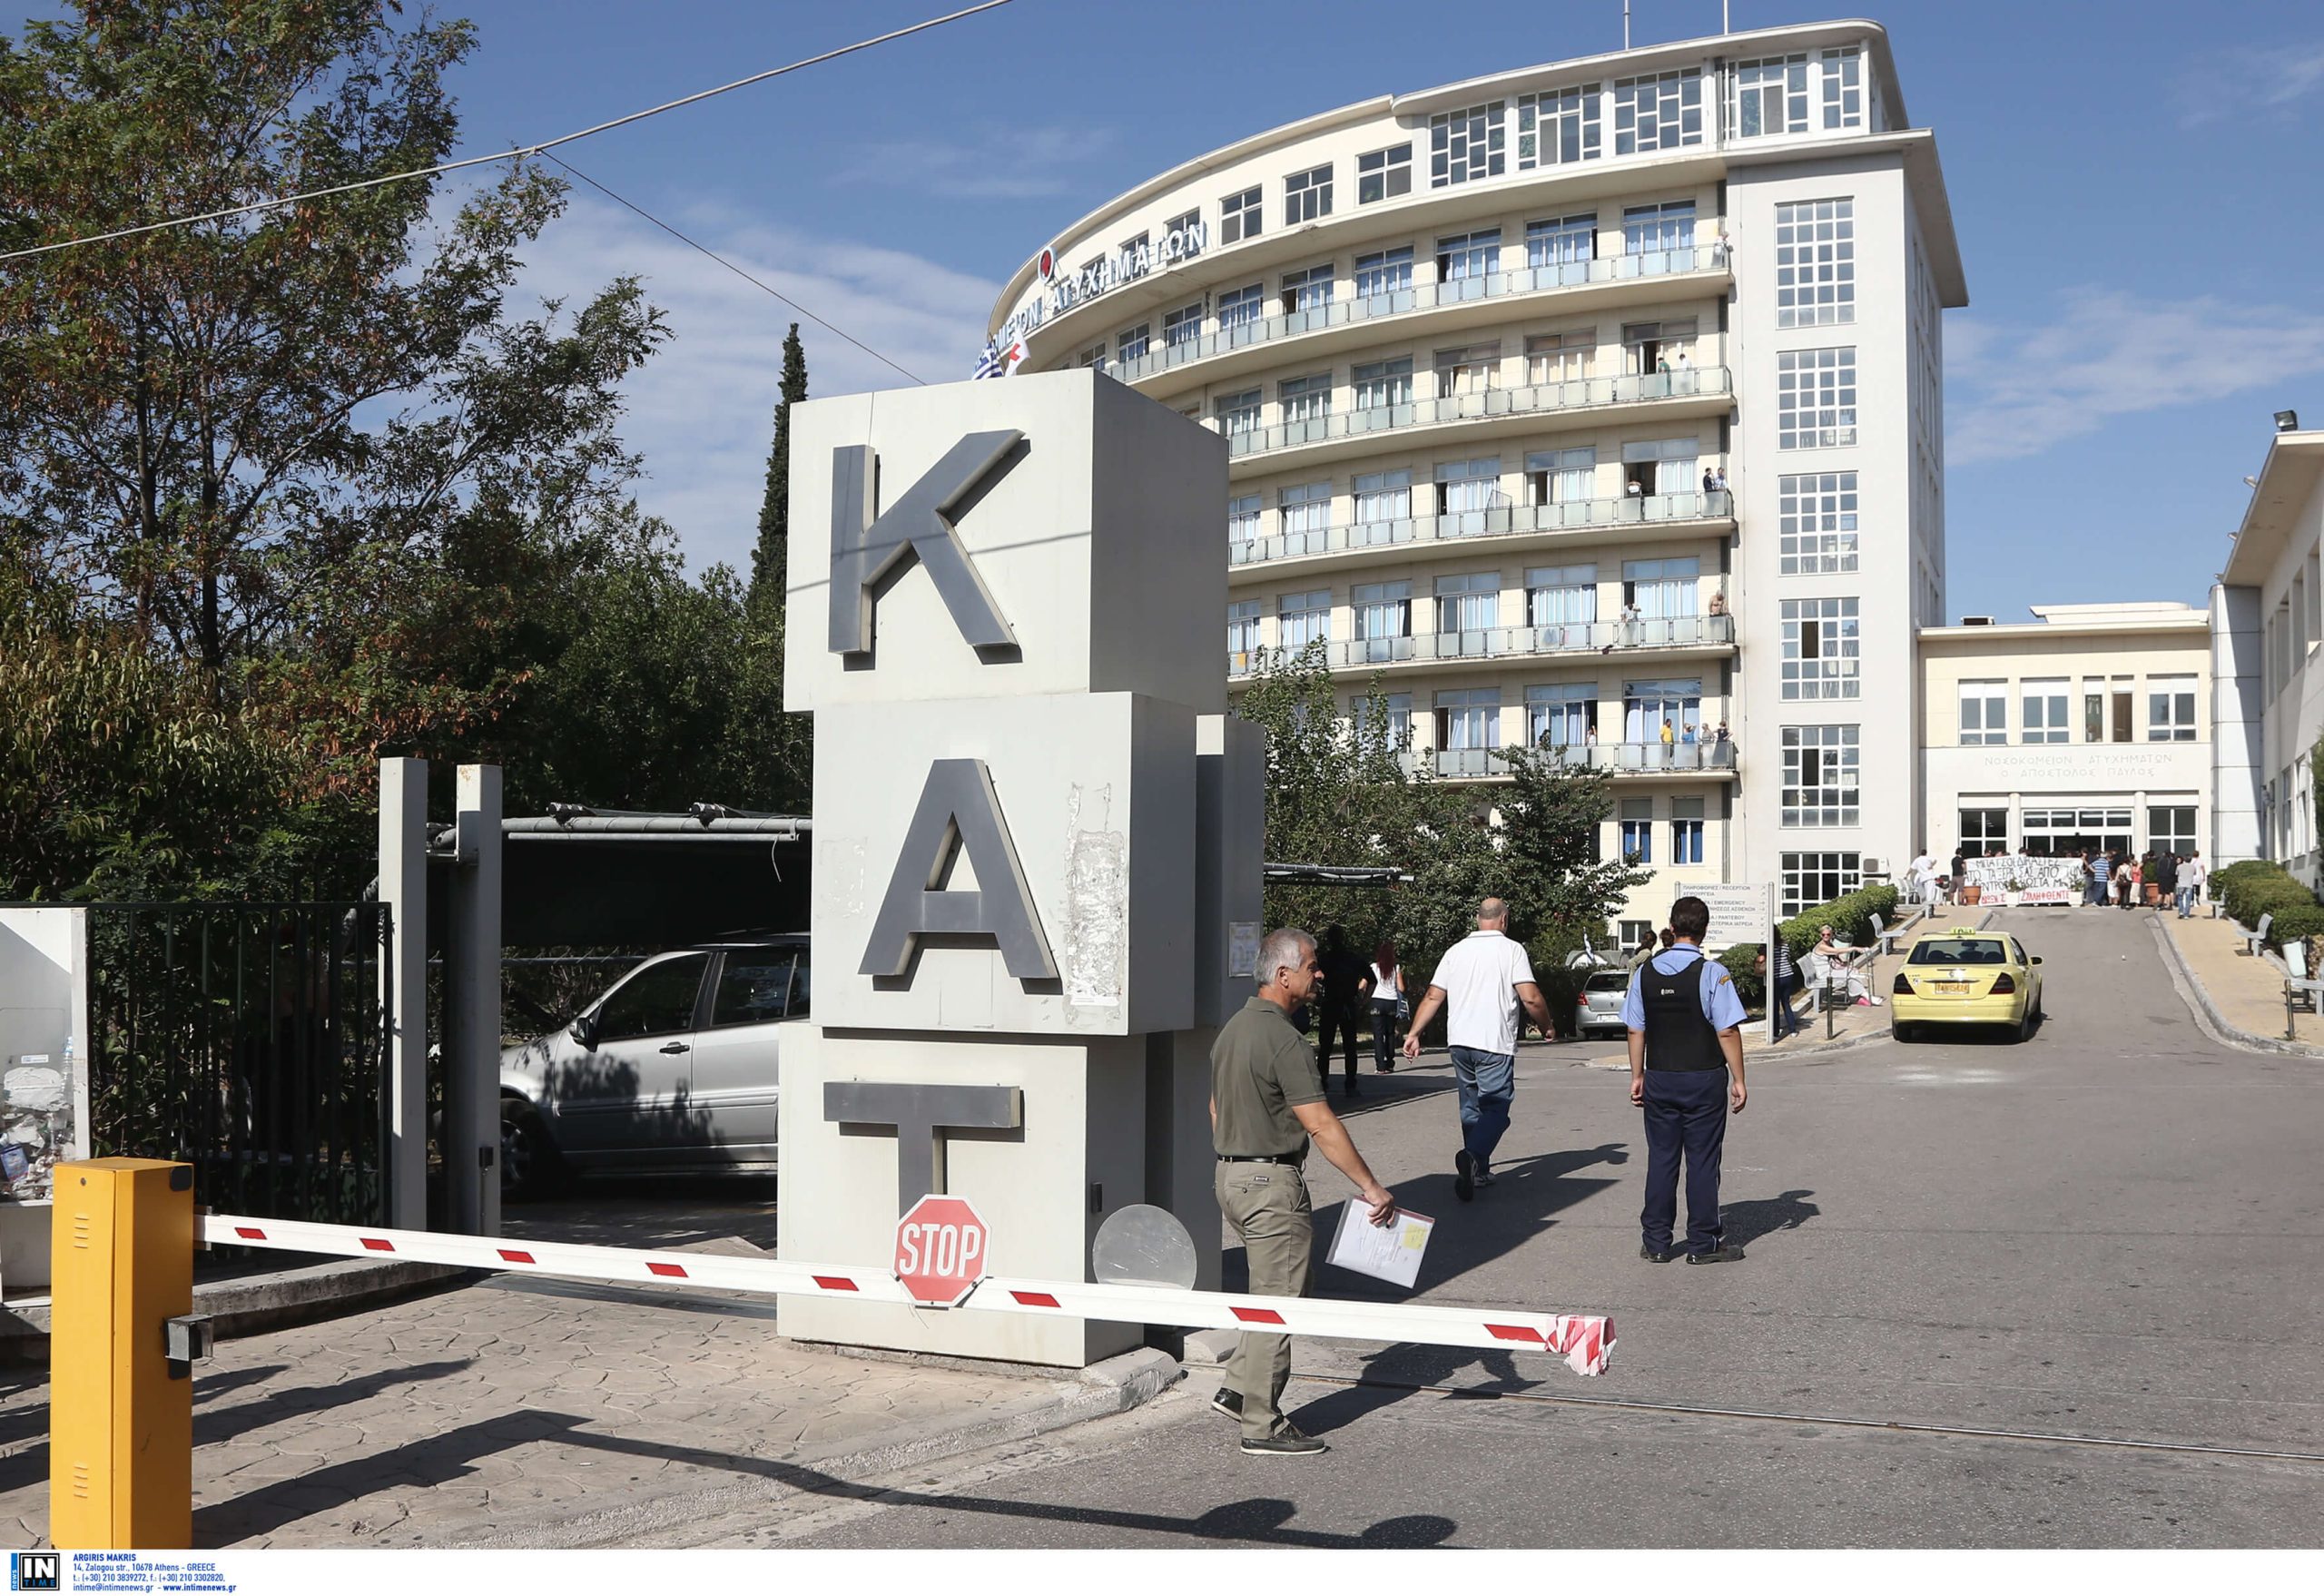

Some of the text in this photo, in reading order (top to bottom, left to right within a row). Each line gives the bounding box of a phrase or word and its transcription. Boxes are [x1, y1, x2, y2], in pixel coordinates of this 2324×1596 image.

[1051, 221, 1206, 316] ΑΤΥΧΗΜΑΤΩΝ
[1984, 754, 2172, 765] ΝΟΣΟΚΟΜΕΙΟΝ ΑΤΥΧΗΜΑΤΩΝ
[2020, 767, 2096, 778] ΑΠΟΣΤΟΛΟΣ
[2106, 766, 2155, 777] ΠΑΥΛΟΣ
[899, 1222, 981, 1278] STOP
